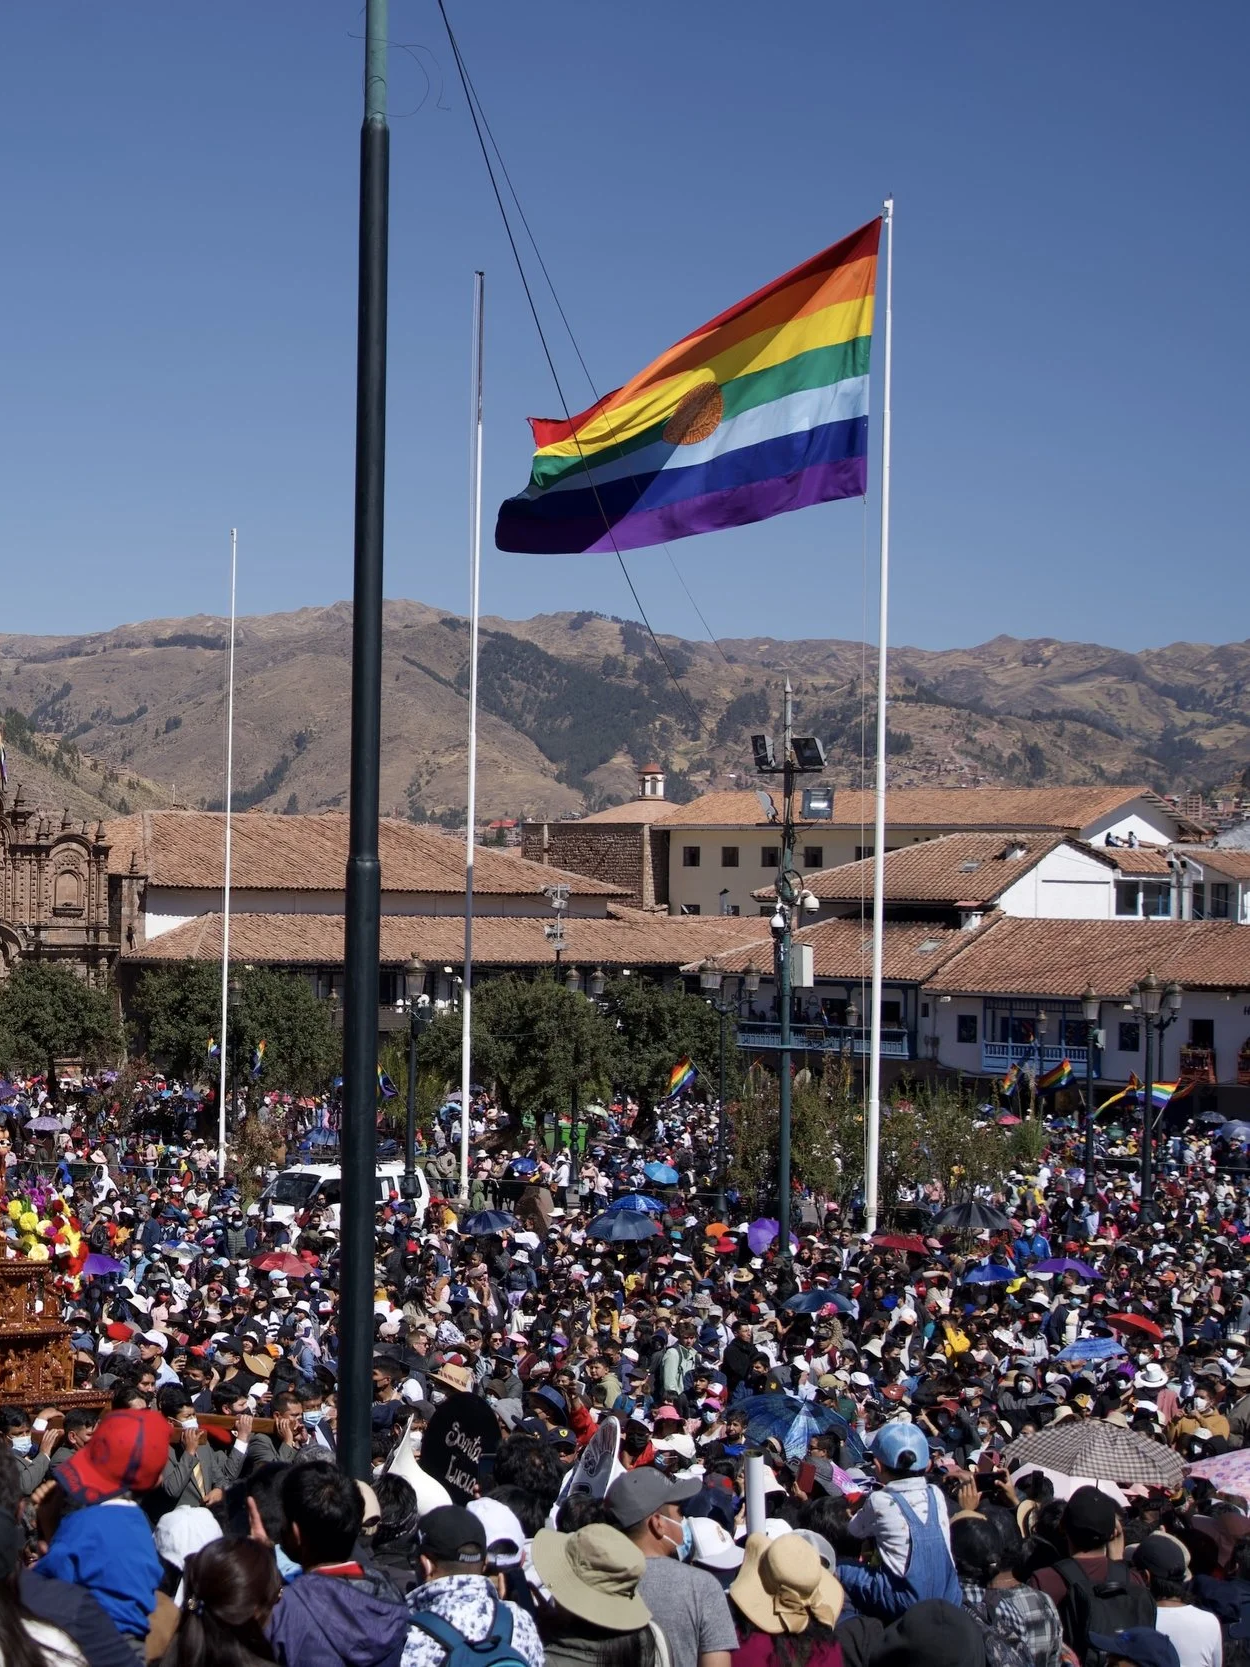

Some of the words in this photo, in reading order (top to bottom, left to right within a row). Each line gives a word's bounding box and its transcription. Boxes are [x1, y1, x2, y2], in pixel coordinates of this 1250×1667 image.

[445, 1421, 483, 1464] Santa
[445, 1455, 477, 1495] Lucia
[459, 1553, 481, 1563] PUMA
